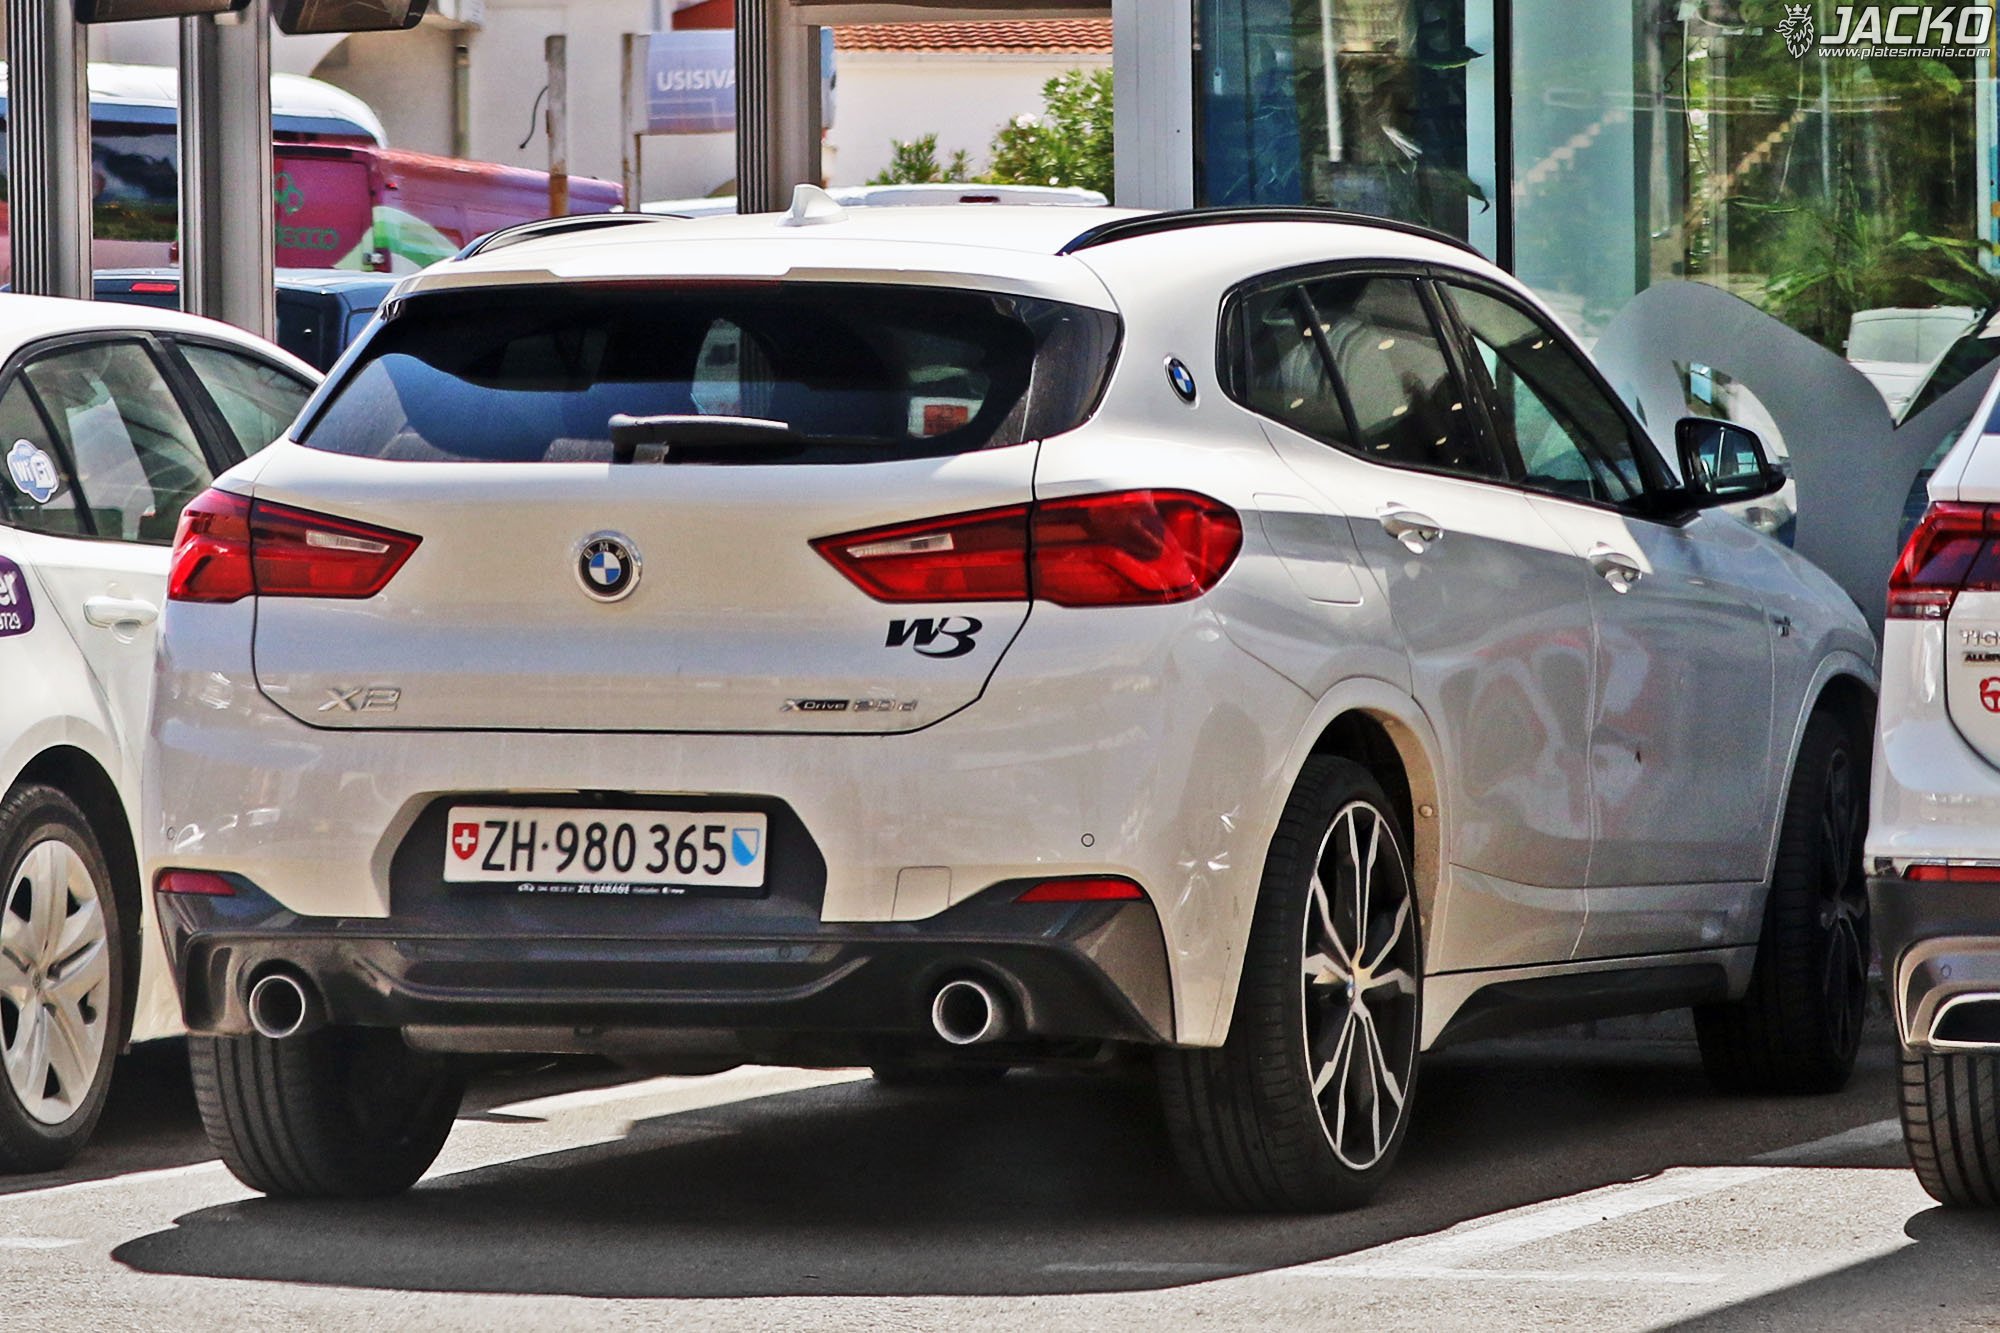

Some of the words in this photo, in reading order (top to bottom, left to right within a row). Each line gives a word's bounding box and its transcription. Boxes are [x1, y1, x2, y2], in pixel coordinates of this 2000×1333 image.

[317, 687, 401, 712] X2
[646, 824, 727, 875] 365
[592, 884, 630, 894] GARAGE
